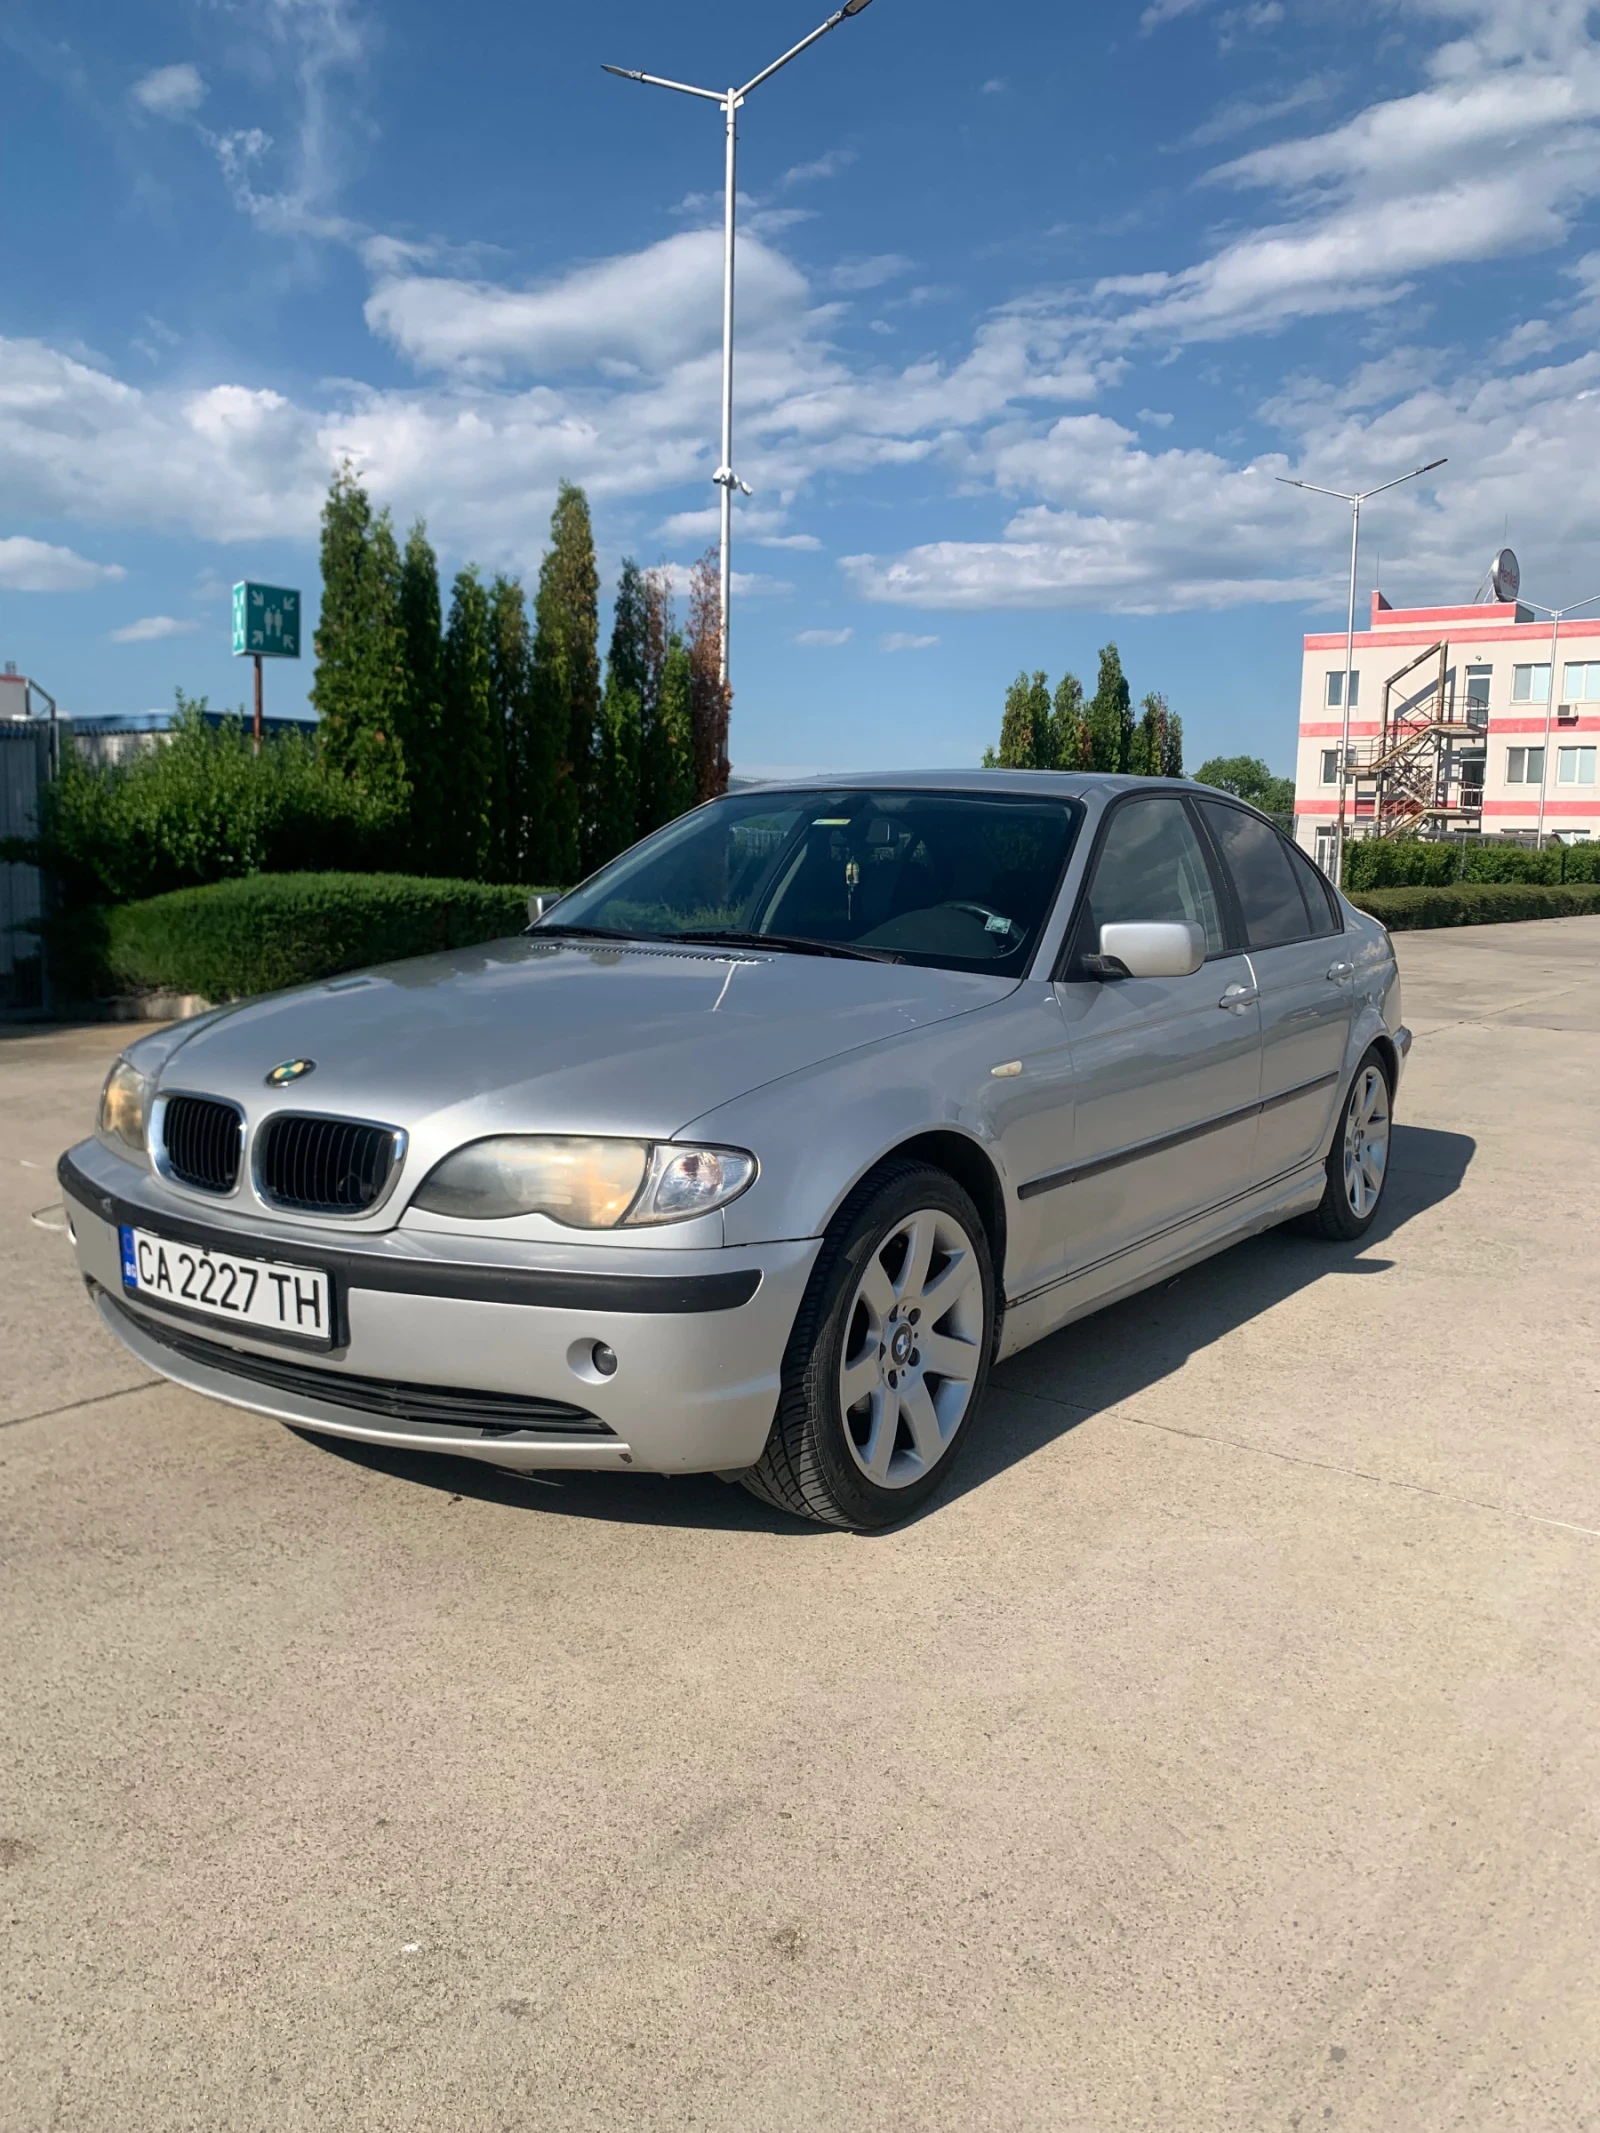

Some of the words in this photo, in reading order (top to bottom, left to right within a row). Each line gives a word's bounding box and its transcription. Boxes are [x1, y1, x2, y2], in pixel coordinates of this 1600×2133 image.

[138, 1240, 173, 1294] CA
[178, 1253, 259, 1313] 2227
[268, 1271, 321, 1328] TH
